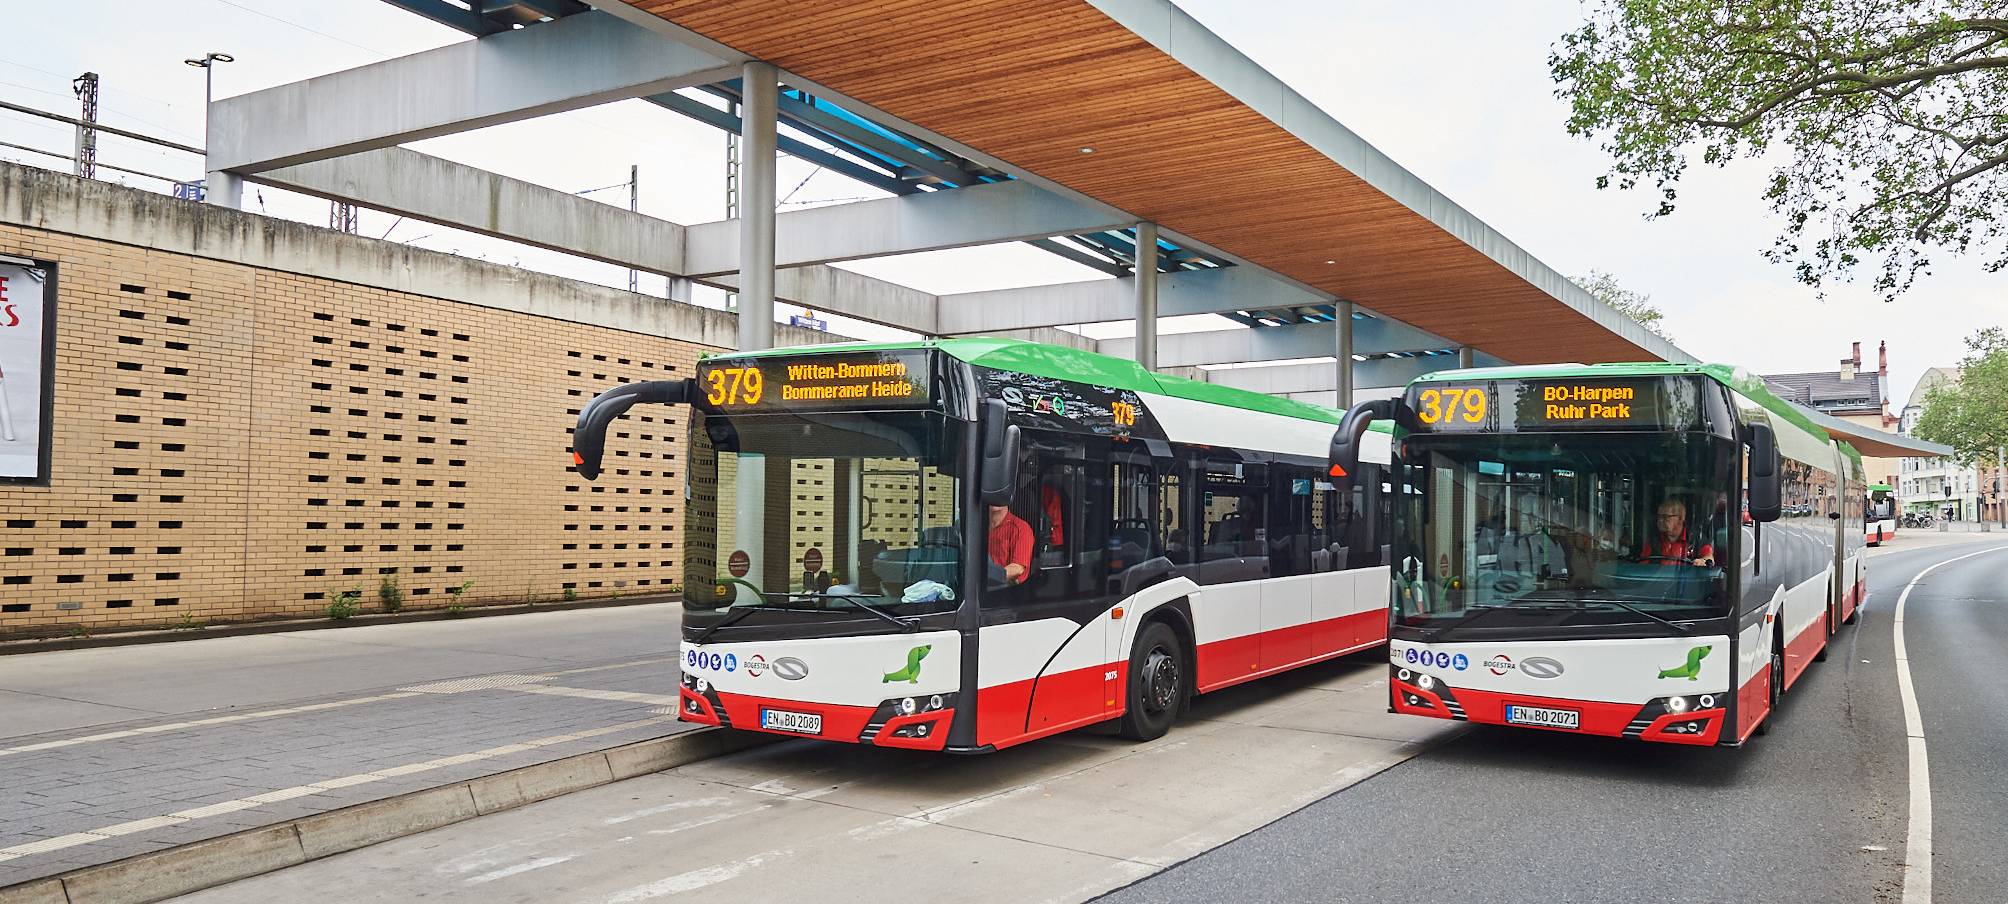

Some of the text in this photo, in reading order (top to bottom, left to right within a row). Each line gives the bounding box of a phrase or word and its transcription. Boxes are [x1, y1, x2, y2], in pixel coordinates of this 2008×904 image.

[174, 184, 182, 199] 2
[788, 362, 906, 381] Witten-Bommern
[707, 367, 763, 406] 379
[782, 380, 912, 401] Bommeraner Heide
[1544, 385, 1633, 403] BO-Harpen
[1111, 401, 1135, 426] 379
[1419, 388, 1486, 424] 379
[1546, 403, 1630, 420] Ruhr Park
[744, 661, 770, 670] BOGESTRA
[1483, 660, 1516, 670] BOGESTRA
[768, 711, 779, 725] EN
[784, 713, 796, 727] BO
[797, 715, 820, 730] 2089
[1513, 707, 1527, 720] EN
[1535, 709, 1548, 722] BO
[1550, 711, 1577, 725] 2071
